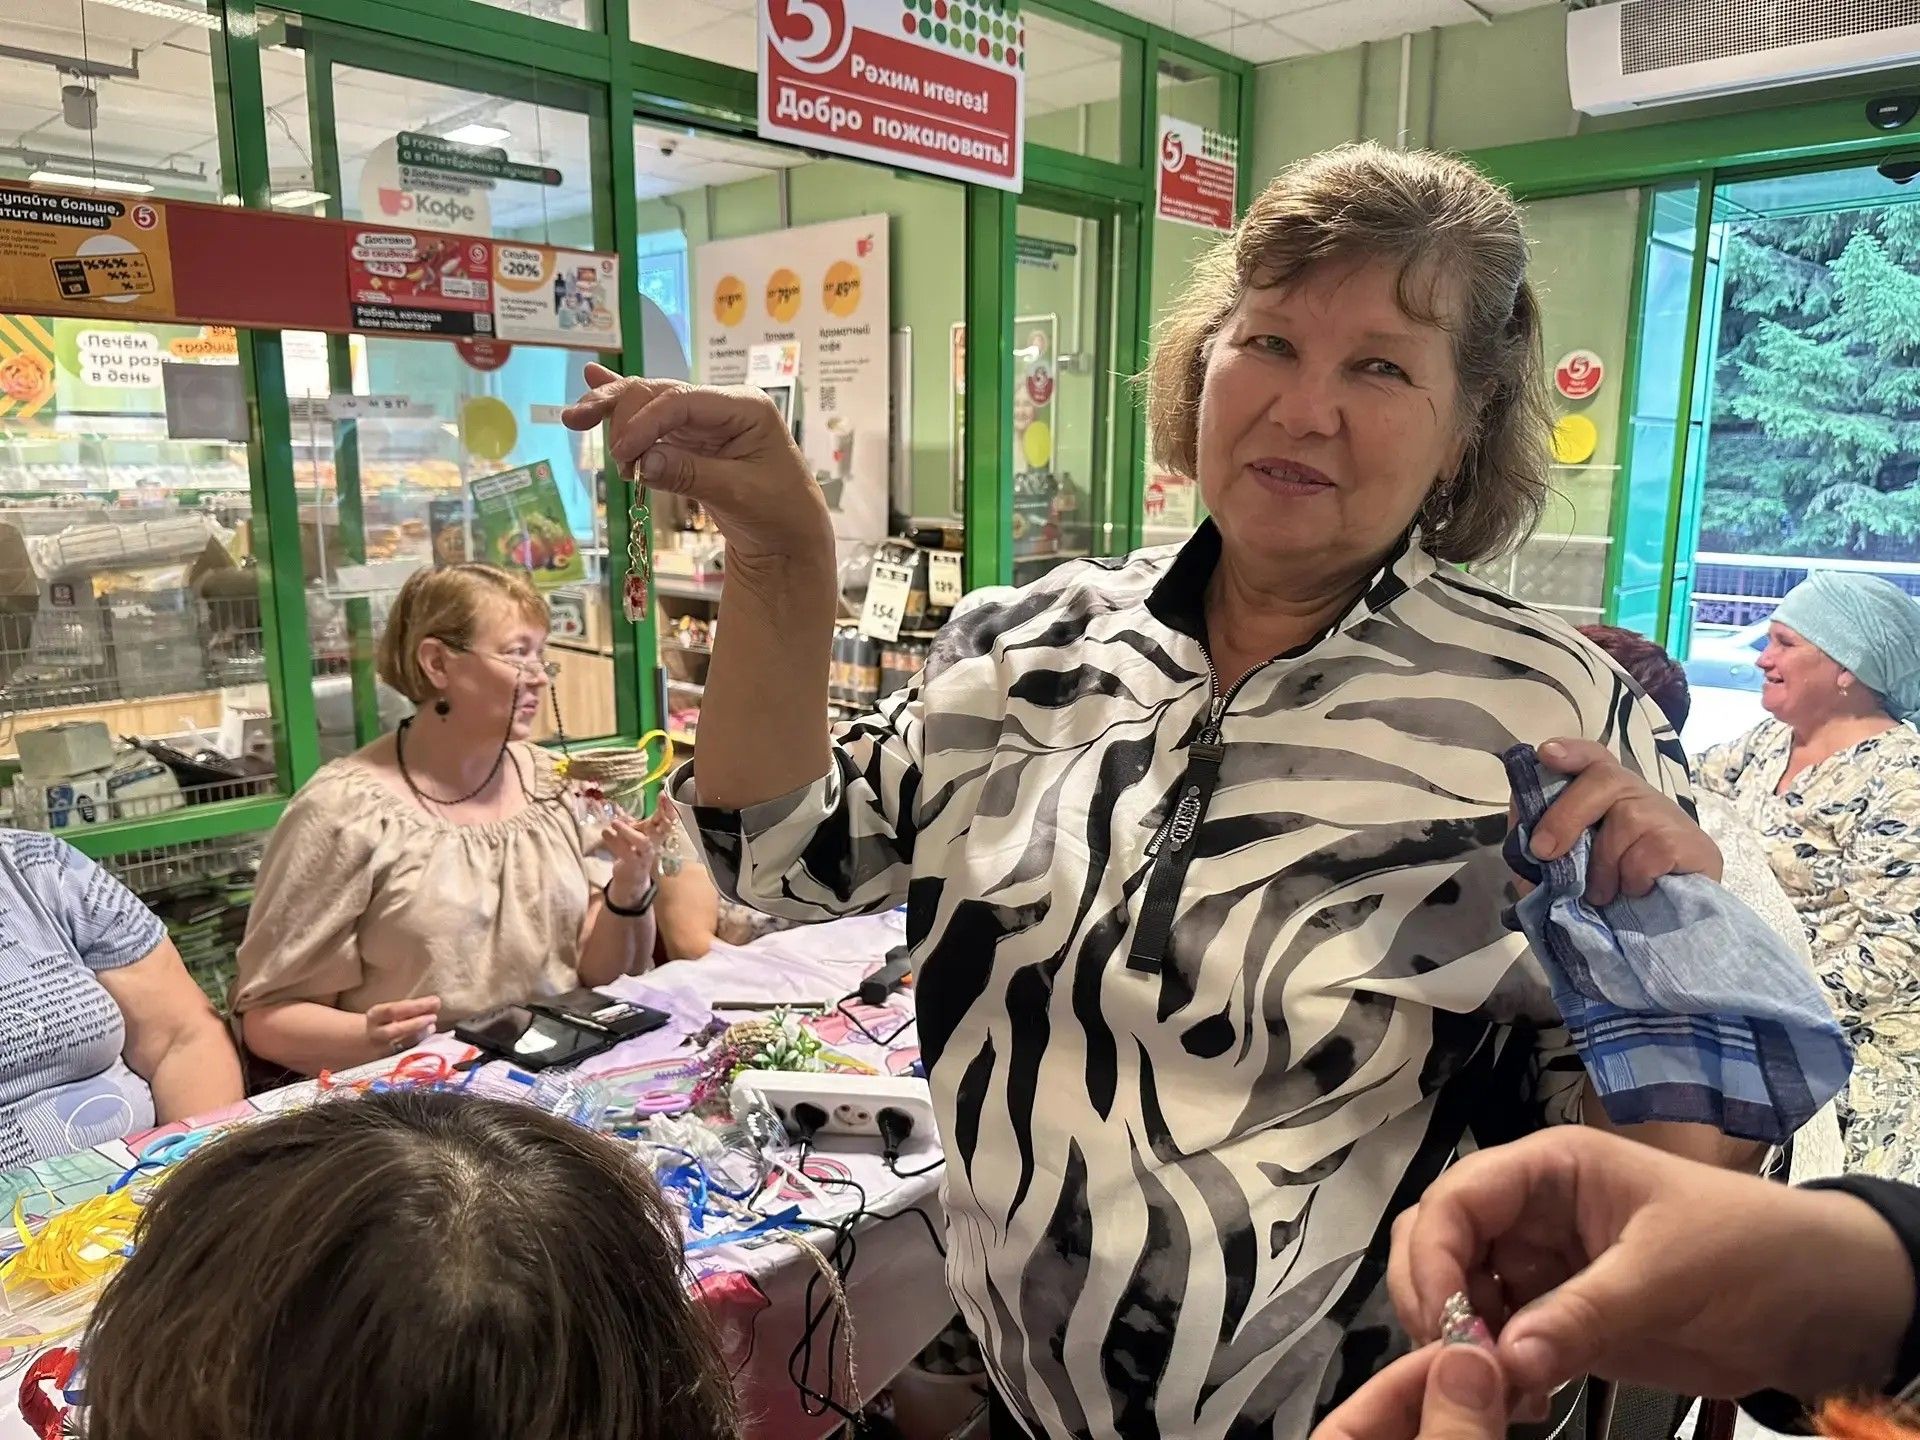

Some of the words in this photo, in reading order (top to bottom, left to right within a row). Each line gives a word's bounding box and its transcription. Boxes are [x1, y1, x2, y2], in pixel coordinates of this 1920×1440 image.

[851, 54, 919, 95] Рәхим
[923, 77, 989, 114] итегез!
[776, 87, 863, 132] Добро
[872, 114, 1009, 166] пожаловать!
[61, 196, 120, 217] больше,
[416, 194, 475, 222] Кофе
[42, 213, 105, 228] меньше!
[88, 334, 148, 348] Печём
[91, 354, 122, 367] три
[92, 372, 101, 382] в
[107, 370, 151, 383] день
